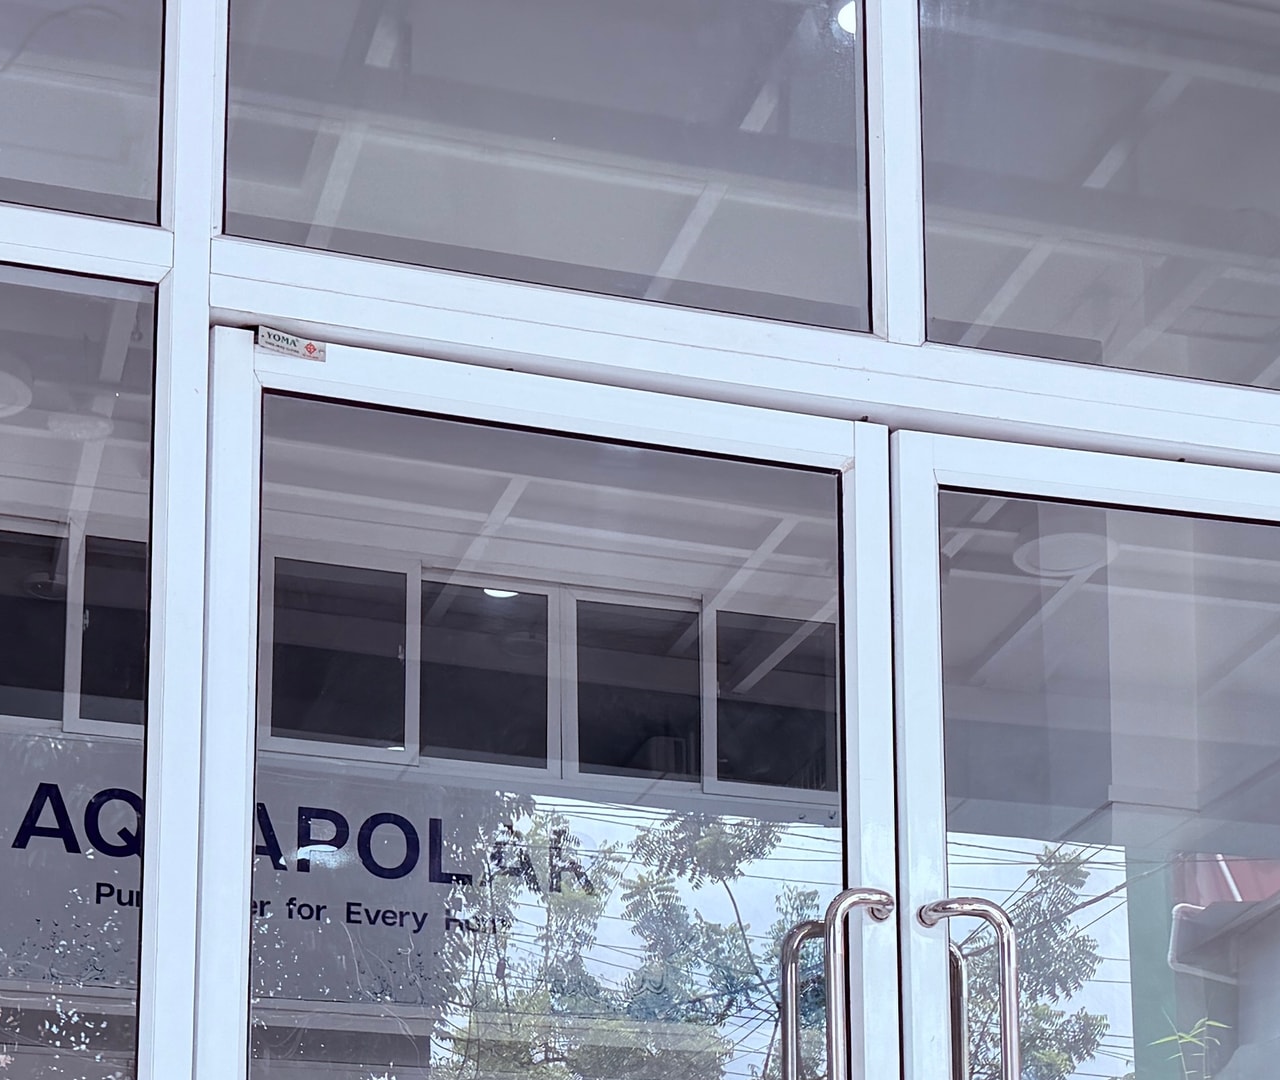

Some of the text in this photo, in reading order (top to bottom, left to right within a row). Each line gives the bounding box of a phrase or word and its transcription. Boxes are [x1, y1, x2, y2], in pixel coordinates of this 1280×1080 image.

[12, 781, 595, 896] AQAPOLAR
[287, 896, 327, 922] for
[346, 902, 428, 935] Every
